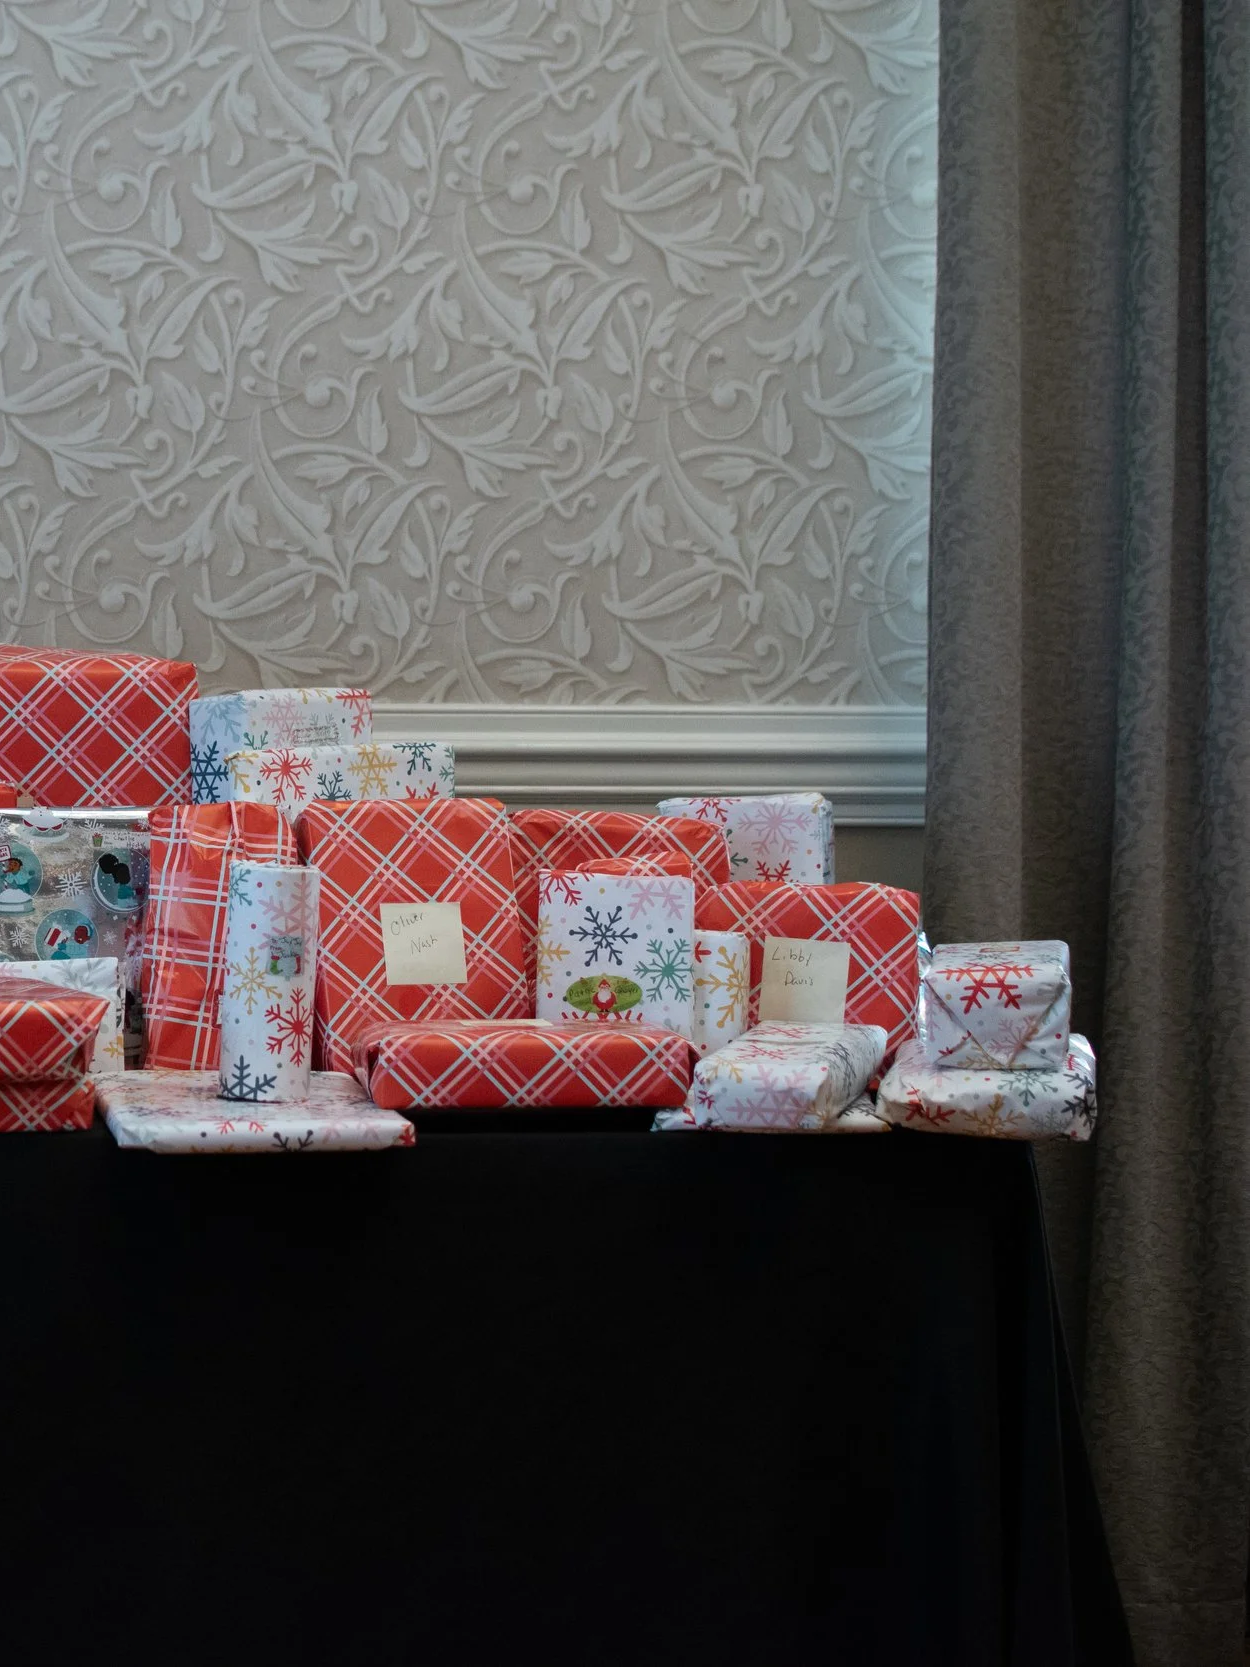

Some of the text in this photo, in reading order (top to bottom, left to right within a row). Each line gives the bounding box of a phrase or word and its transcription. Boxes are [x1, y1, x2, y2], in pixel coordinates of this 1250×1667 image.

[390, 913, 424, 937] Oliver
[410, 934, 439, 956] Nash
[771, 946, 812, 967] Libby
[784, 970, 814, 986] Davis
